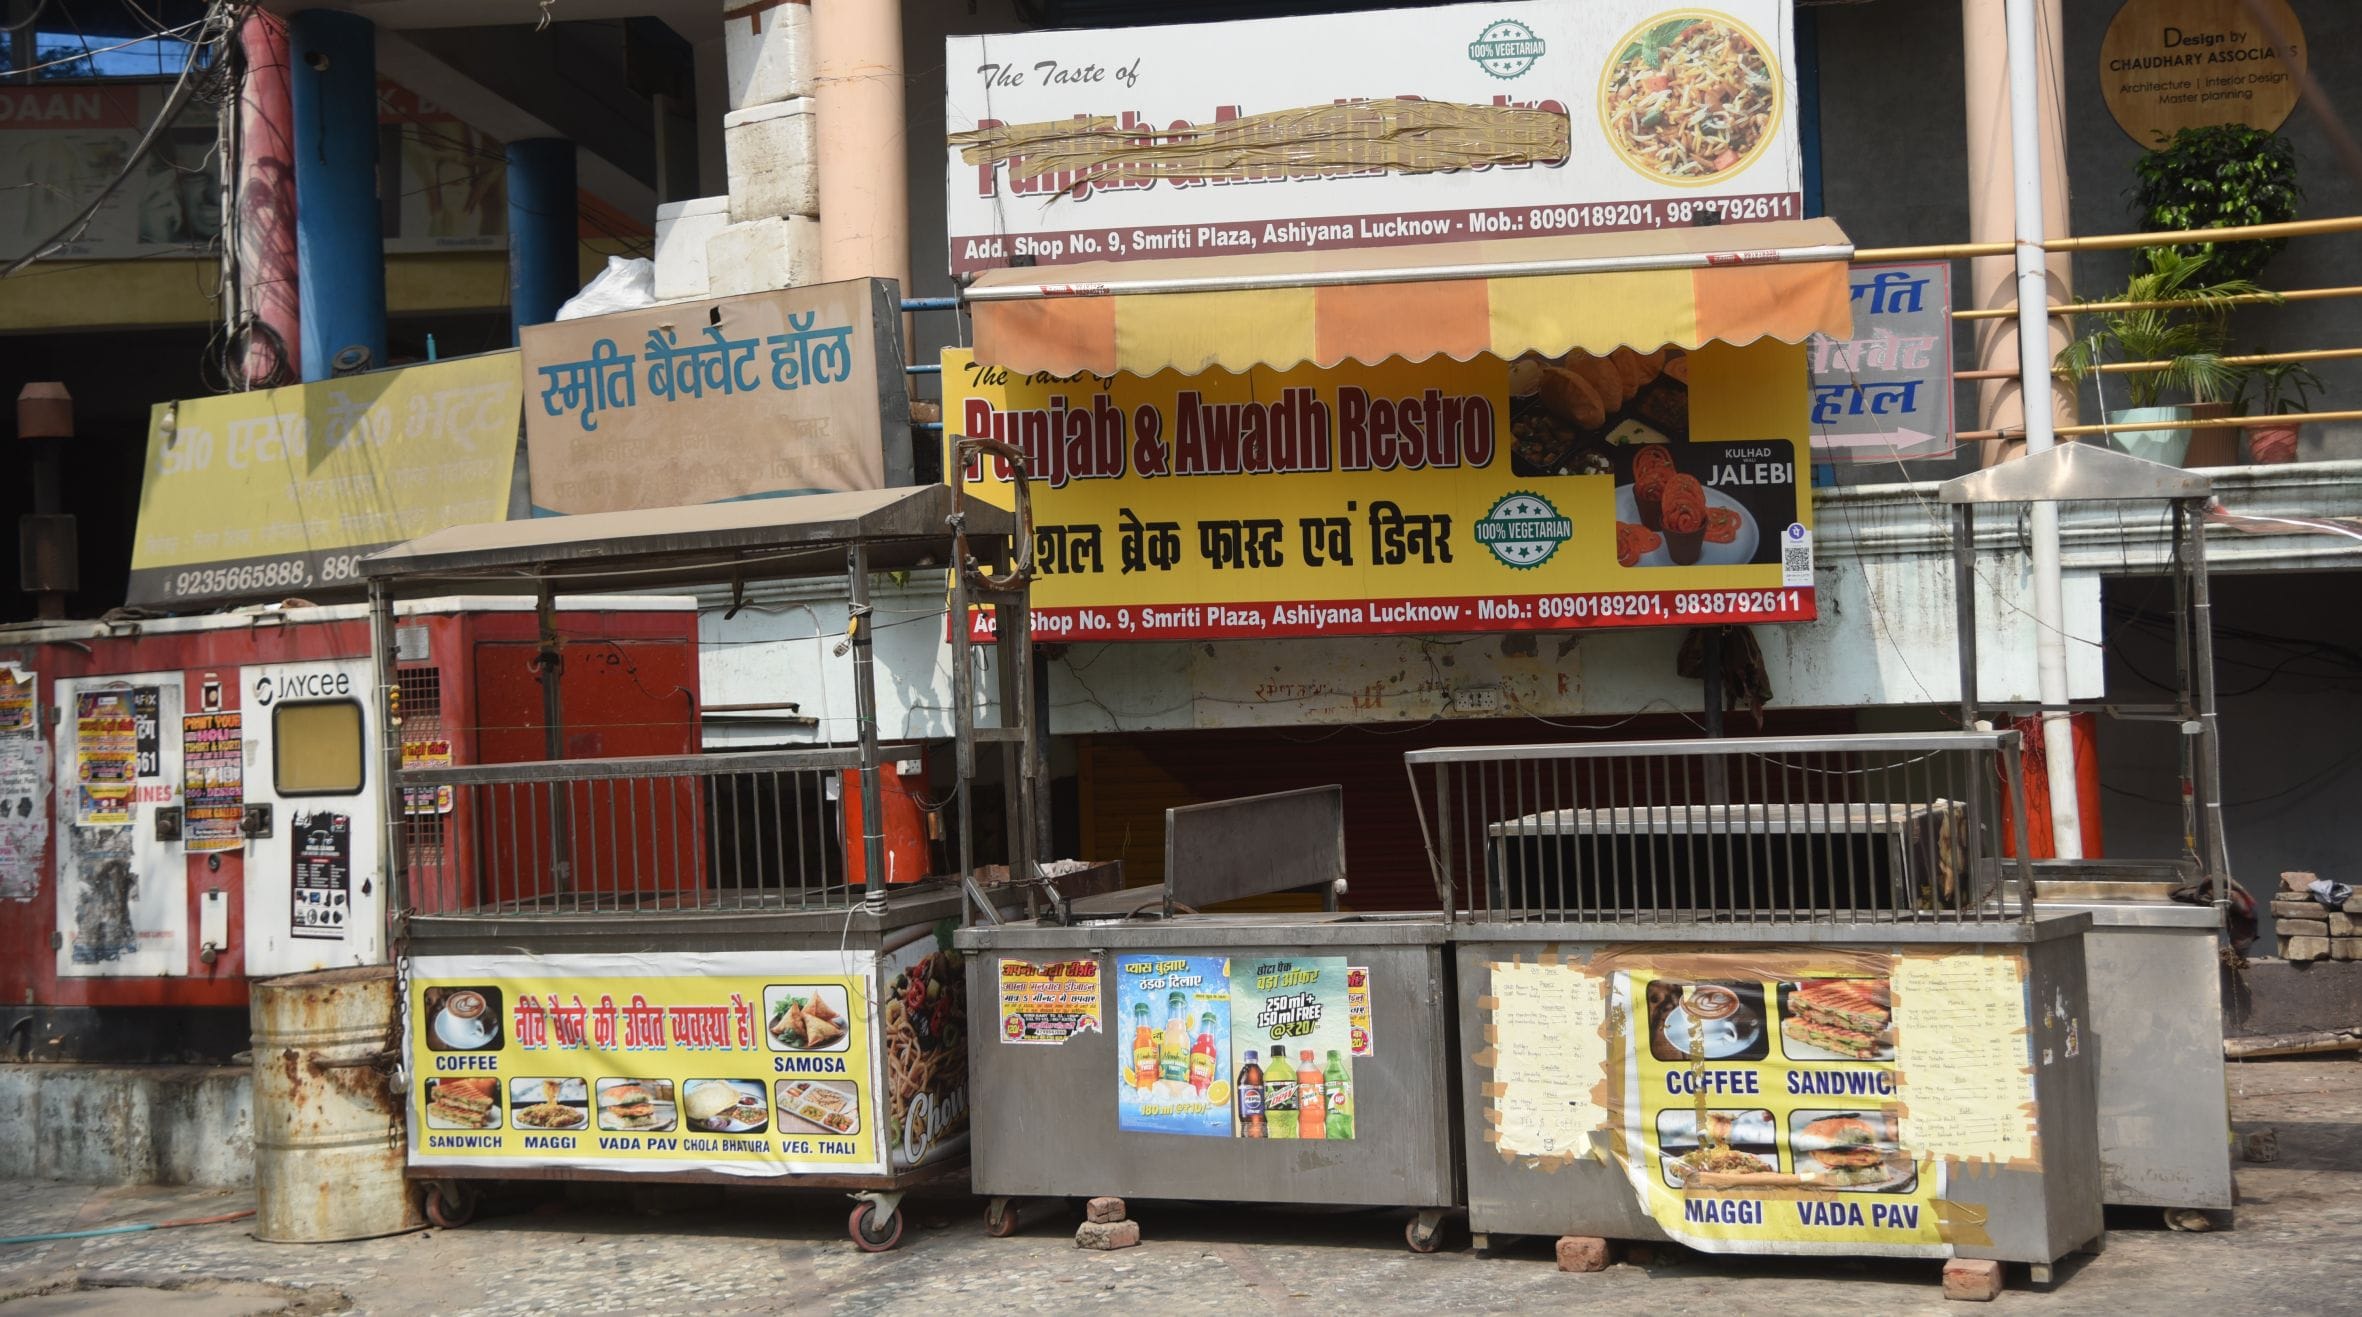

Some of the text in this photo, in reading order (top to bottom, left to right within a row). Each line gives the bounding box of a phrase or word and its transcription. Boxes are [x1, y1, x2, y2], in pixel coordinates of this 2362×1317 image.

[1470, 40, 1544, 58] 100% VEGETARIAN
[2163, 27, 2247, 48] Design by
[2110, 46, 2298, 71] CHAUDHARY ASSOCIAS
[976, 58, 1141, 89] The Taste of
[2120, 72, 2289, 94] Architecture Interior Design
[2159, 89, 2253, 104] Master planning
[964, 239, 1008, 259] Add.
[1015, 236, 1063, 259] Shop
[1070, 232, 1101, 254] No.
[1108, 232, 1125, 254] 9,
[1132, 226, 1191, 250] Smriti
[1197, 223, 1257, 248] Plaza,
[1263, 220, 1353, 245] Ashiyana
[1360, 215, 1450, 240] Lucknow
[1469, 211, 1523, 232] Mob.:
[1530, 203, 1661, 228] 8090189201,
[538, 310, 853, 431] स्मृति बैंक्वेट हॉल
[964, 362, 1008, 388] The
[964, 384, 1497, 489] Punjab & Awadh Restro
[1725, 447, 1771, 459] KULHAD
[1707, 463, 1793, 486] JALEBI
[1119, 508, 1181, 576] ब्रेक
[1197, 518, 1284, 571] फास्ट
[1299, 501, 1358, 568] एवं
[1368, 501, 1454, 567] डिनर
[1476, 518, 1571, 540] 100% VEGETARIAN
[177, 560, 314, 596] 9235665888,
[1031, 611, 1073, 635] Shop
[1080, 609, 1111, 630] No.
[1118, 608, 1136, 632] 9,
[1142, 606, 1201, 629] Smriti
[1206, 603, 1267, 629] Plaza,
[1272, 603, 1364, 628] Ashiyana
[1370, 601, 1460, 624] Lucknow
[1478, 597, 1532, 619] Mob.:
[1538, 593, 1670, 619] 8090189201,
[1675, 590, 1801, 615] 9838792611
[1266, 996, 1288, 1012] 250
[1258, 1010, 1279, 1028] 150
[1297, 1004, 1321, 1020] FREE
[436, 1055, 497, 1071] COFFEE
[774, 1057, 846, 1073] SAMOSA
[1666, 1070, 1759, 1096] COFFEE
[1787, 1070, 1898, 1097] SANDWIC
[429, 1135, 502, 1149] SANDWICH
[524, 1136, 577, 1149] MAGGI
[599, 1137, 678, 1151] VADA PAV
[683, 1138, 770, 1153] CHOLA BHATURA
[782, 1141, 856, 1155] VEG. THALI
[1685, 1200, 1762, 1225] MAGGI
[1797, 1202, 1919, 1229] VADA PAV
